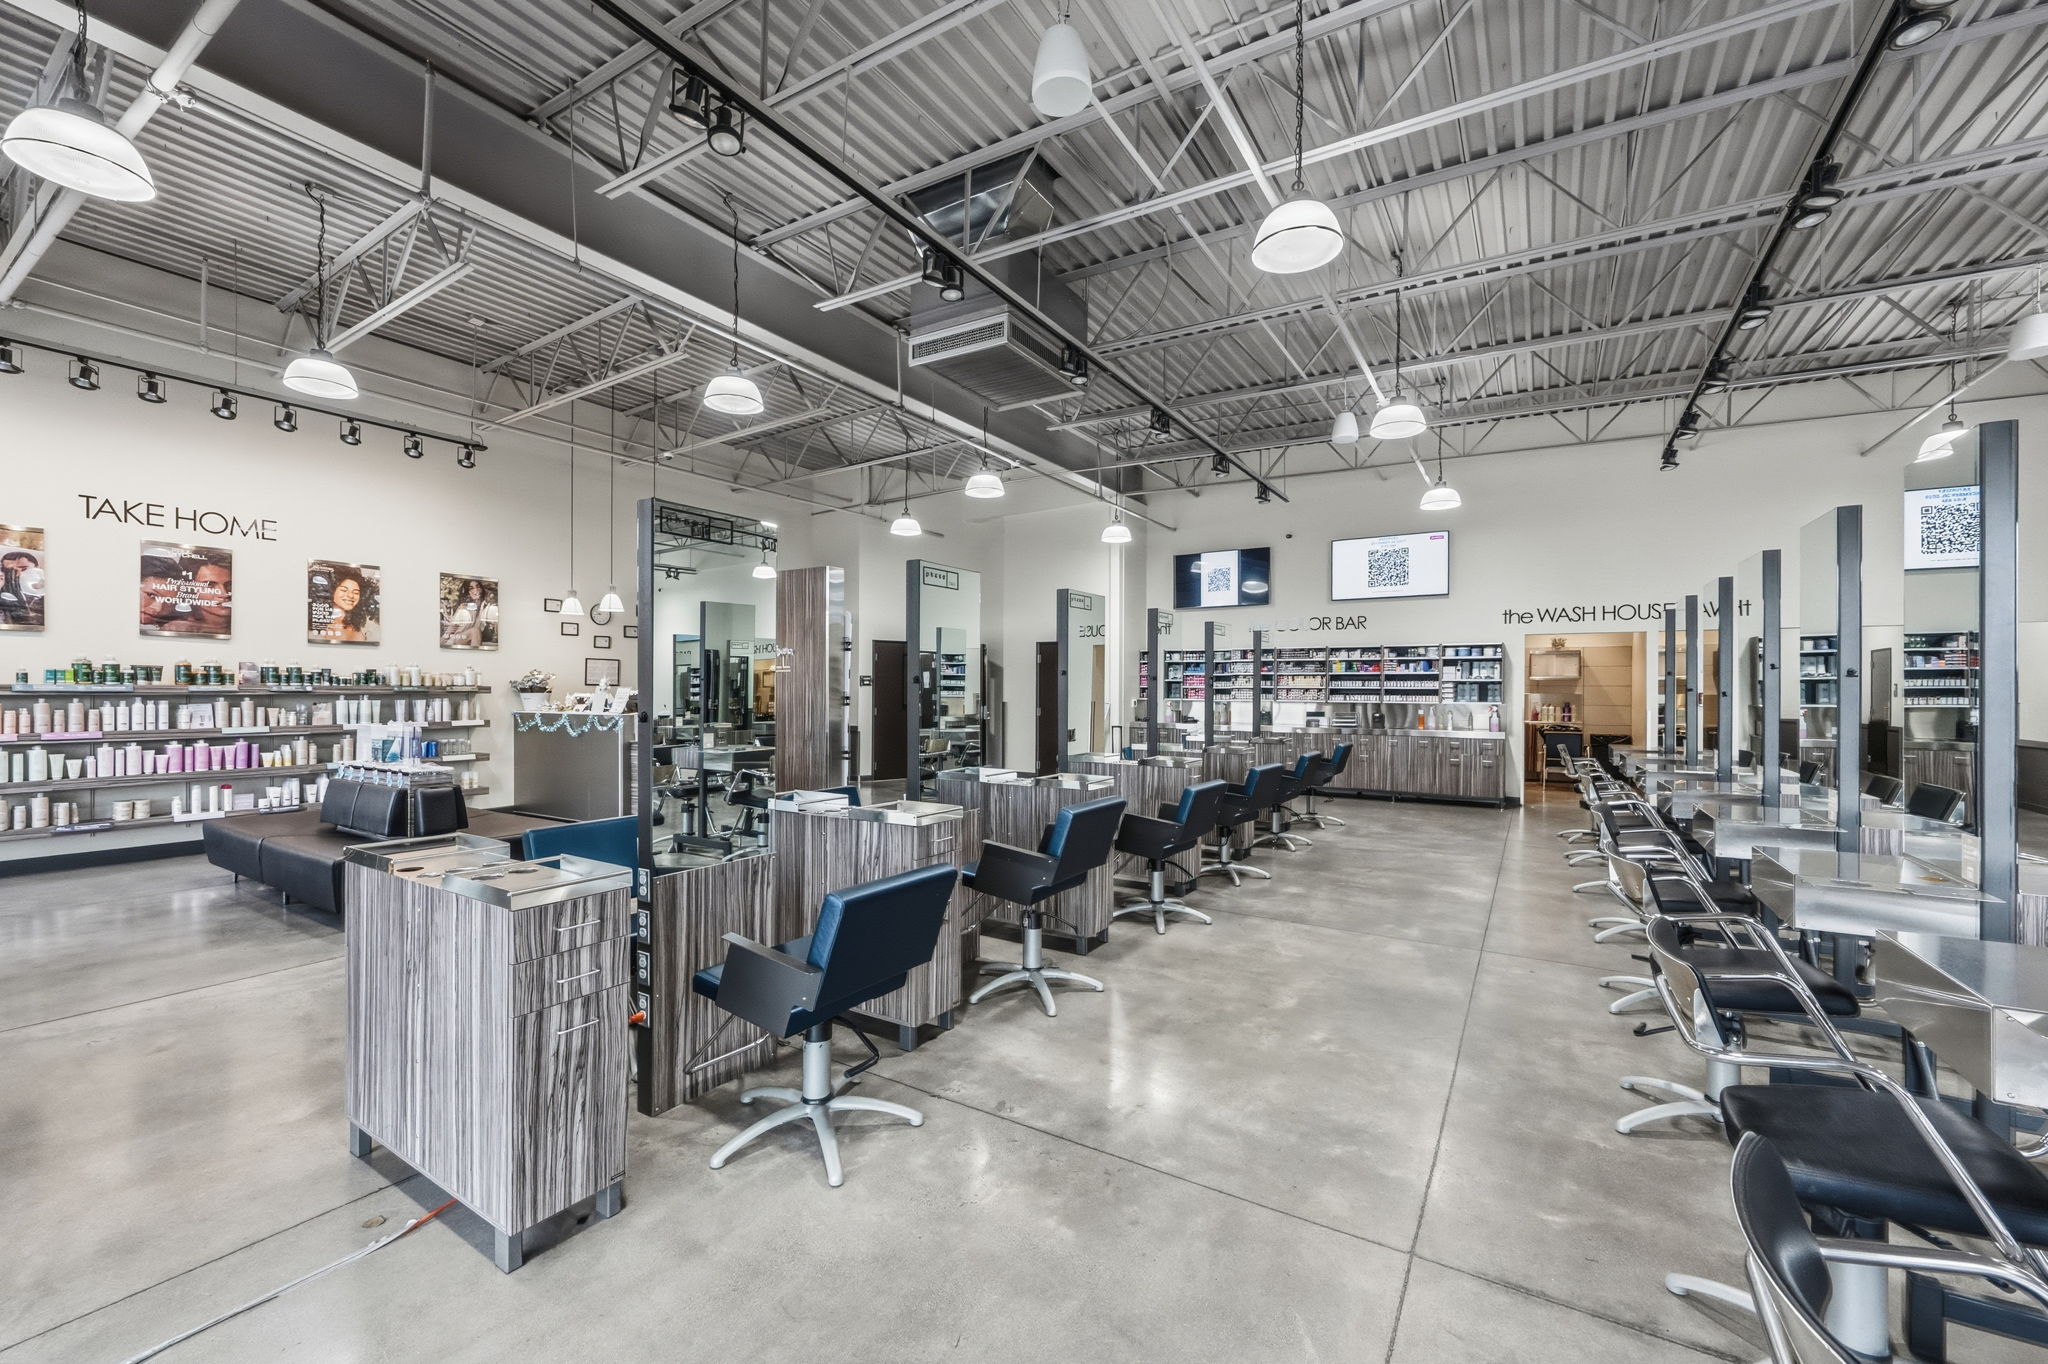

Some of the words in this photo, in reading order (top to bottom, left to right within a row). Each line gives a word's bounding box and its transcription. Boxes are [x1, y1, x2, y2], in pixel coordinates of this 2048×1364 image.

[78, 494, 165, 528] TAKE
[175, 506, 278, 542] HOME
[152, 583, 178, 592] HAIR
[180, 585, 222, 595] STYLING
[176, 591, 200, 599] Brand
[154, 596, 218, 607] WORLDWIDE
[1502, 609, 1533, 625] the
[1537, 606, 1596, 623] WASH
[1336, 616, 1367, 631] BAR
